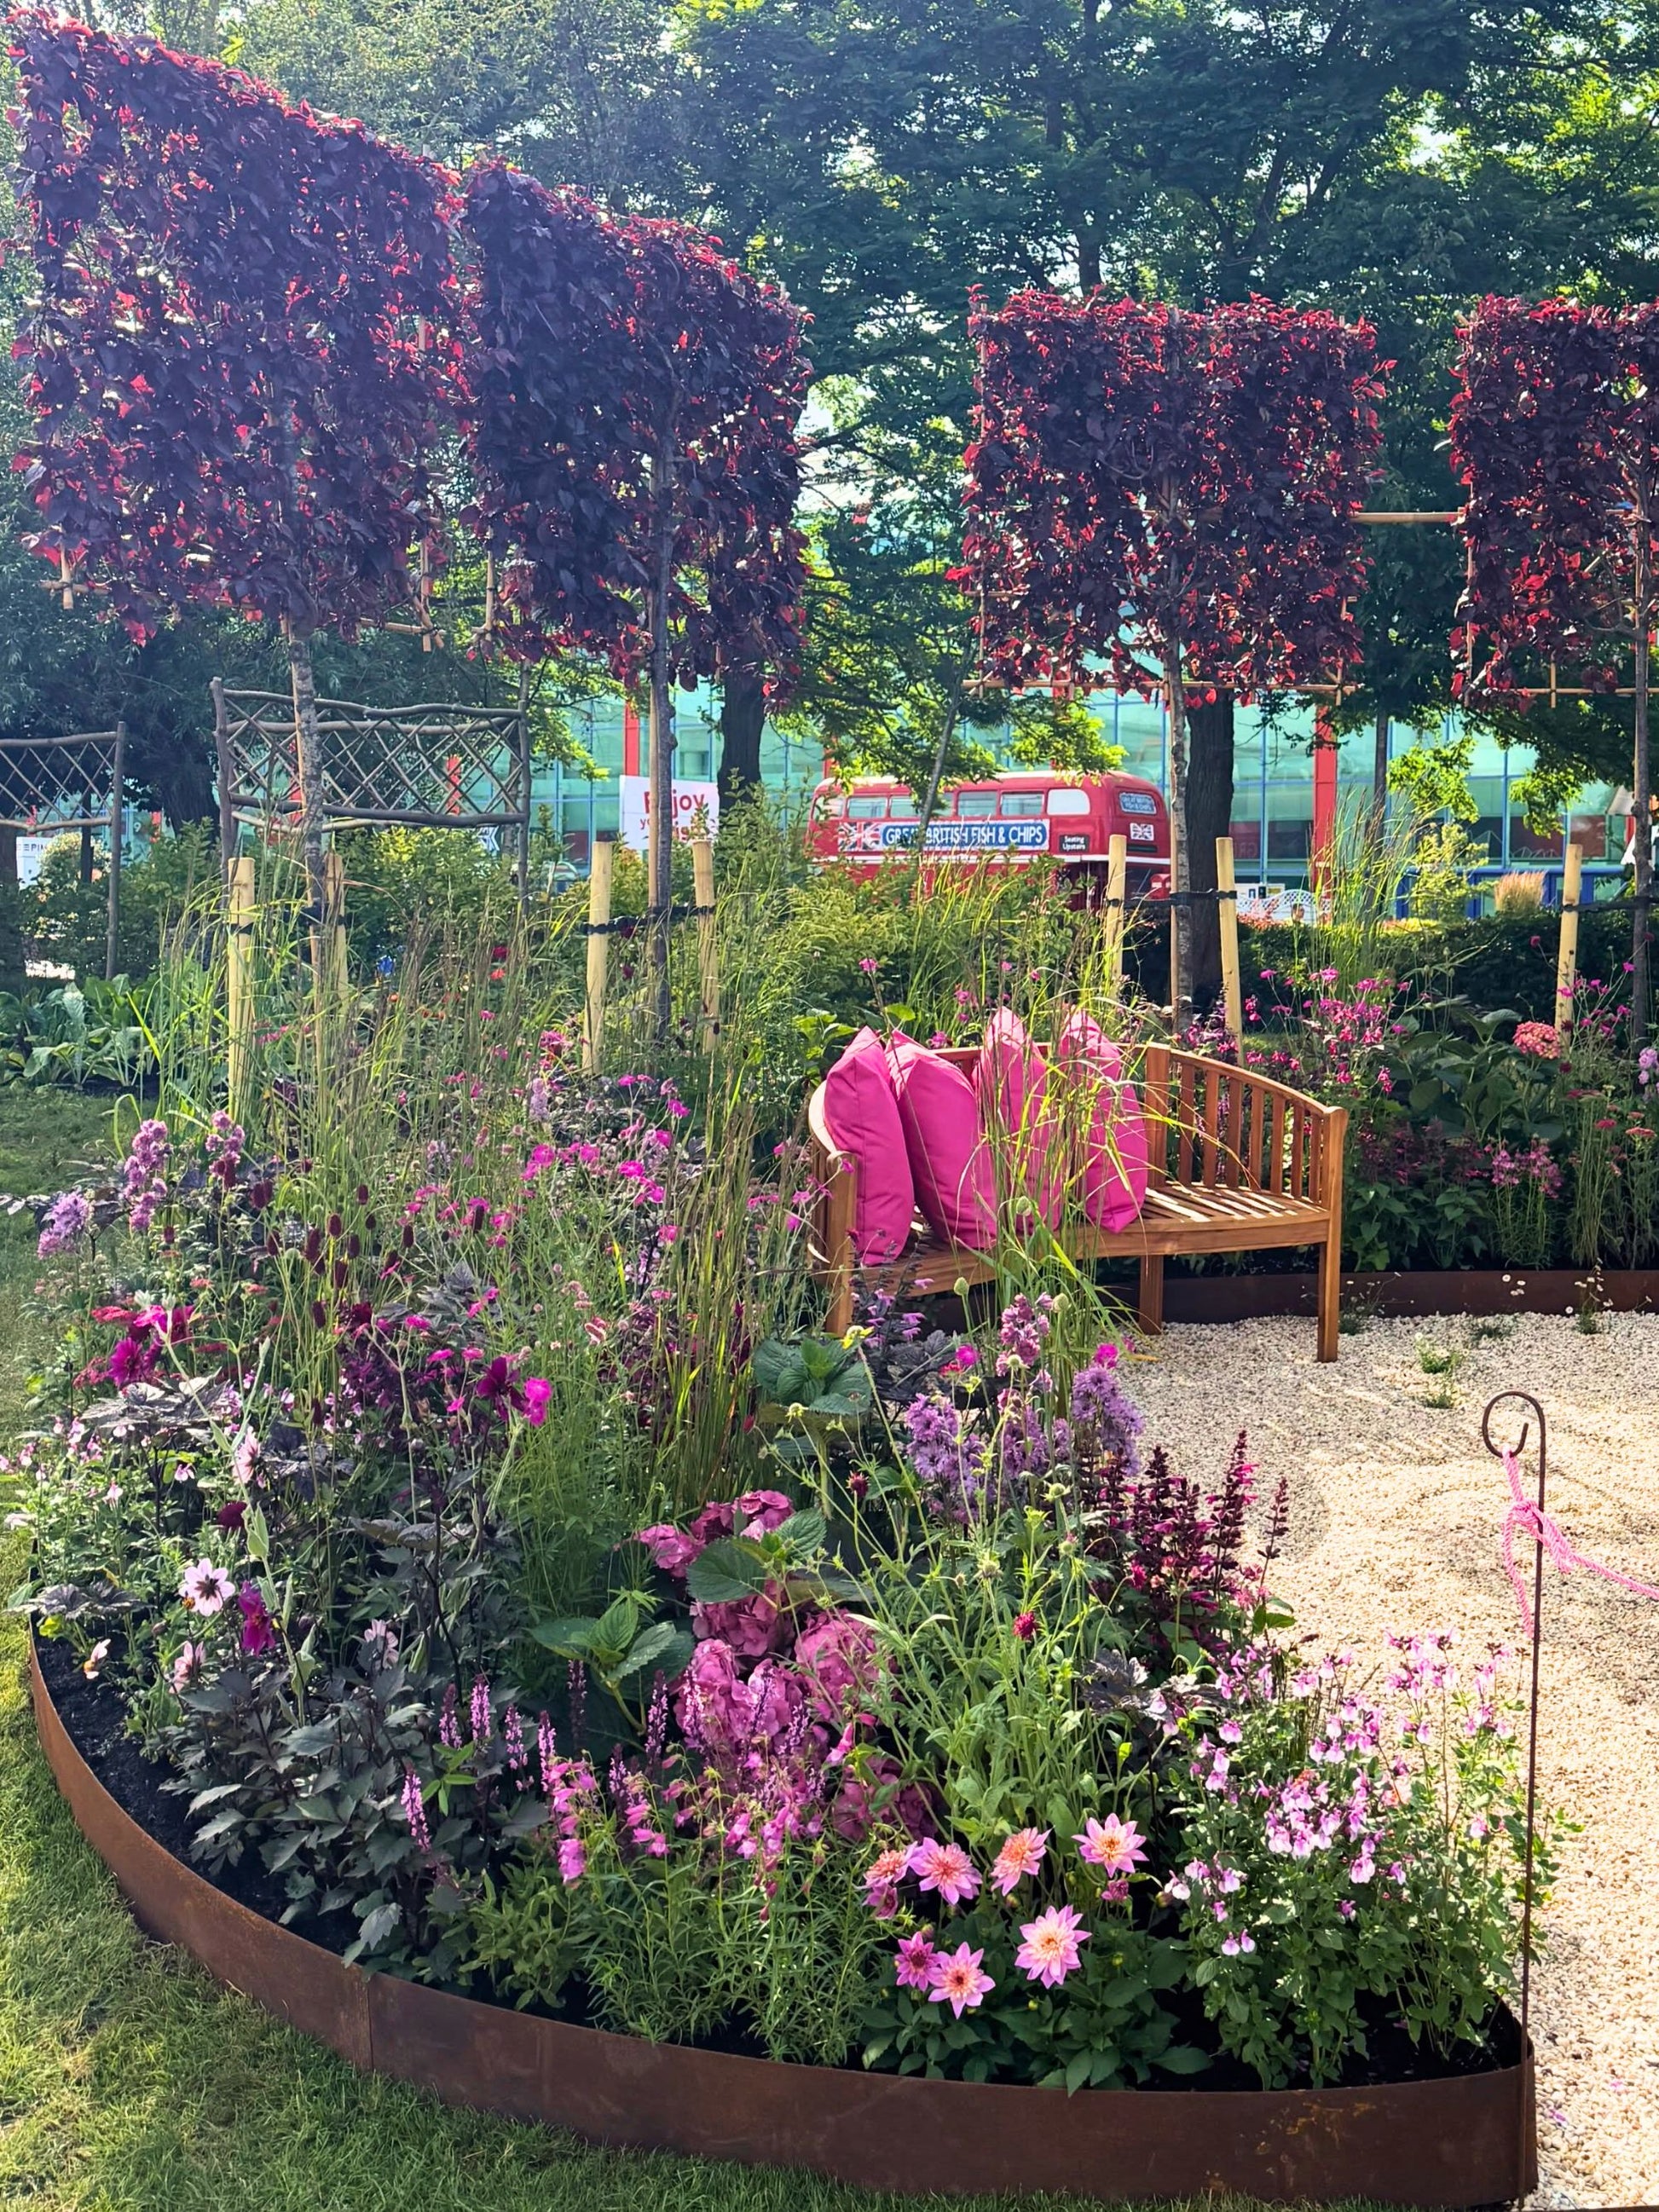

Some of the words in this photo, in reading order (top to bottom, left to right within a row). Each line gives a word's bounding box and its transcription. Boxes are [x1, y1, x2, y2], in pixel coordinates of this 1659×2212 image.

[644, 789, 705, 818] Ejoy
[886, 828, 922, 844] GREA
[926, 827, 968, 844] BRITISH
[971, 826, 996, 844] FISH
[998, 826, 1006, 844] &
[1009, 826, 1043, 844] CHIPS
[1062, 843, 1086, 852] Upstairs
